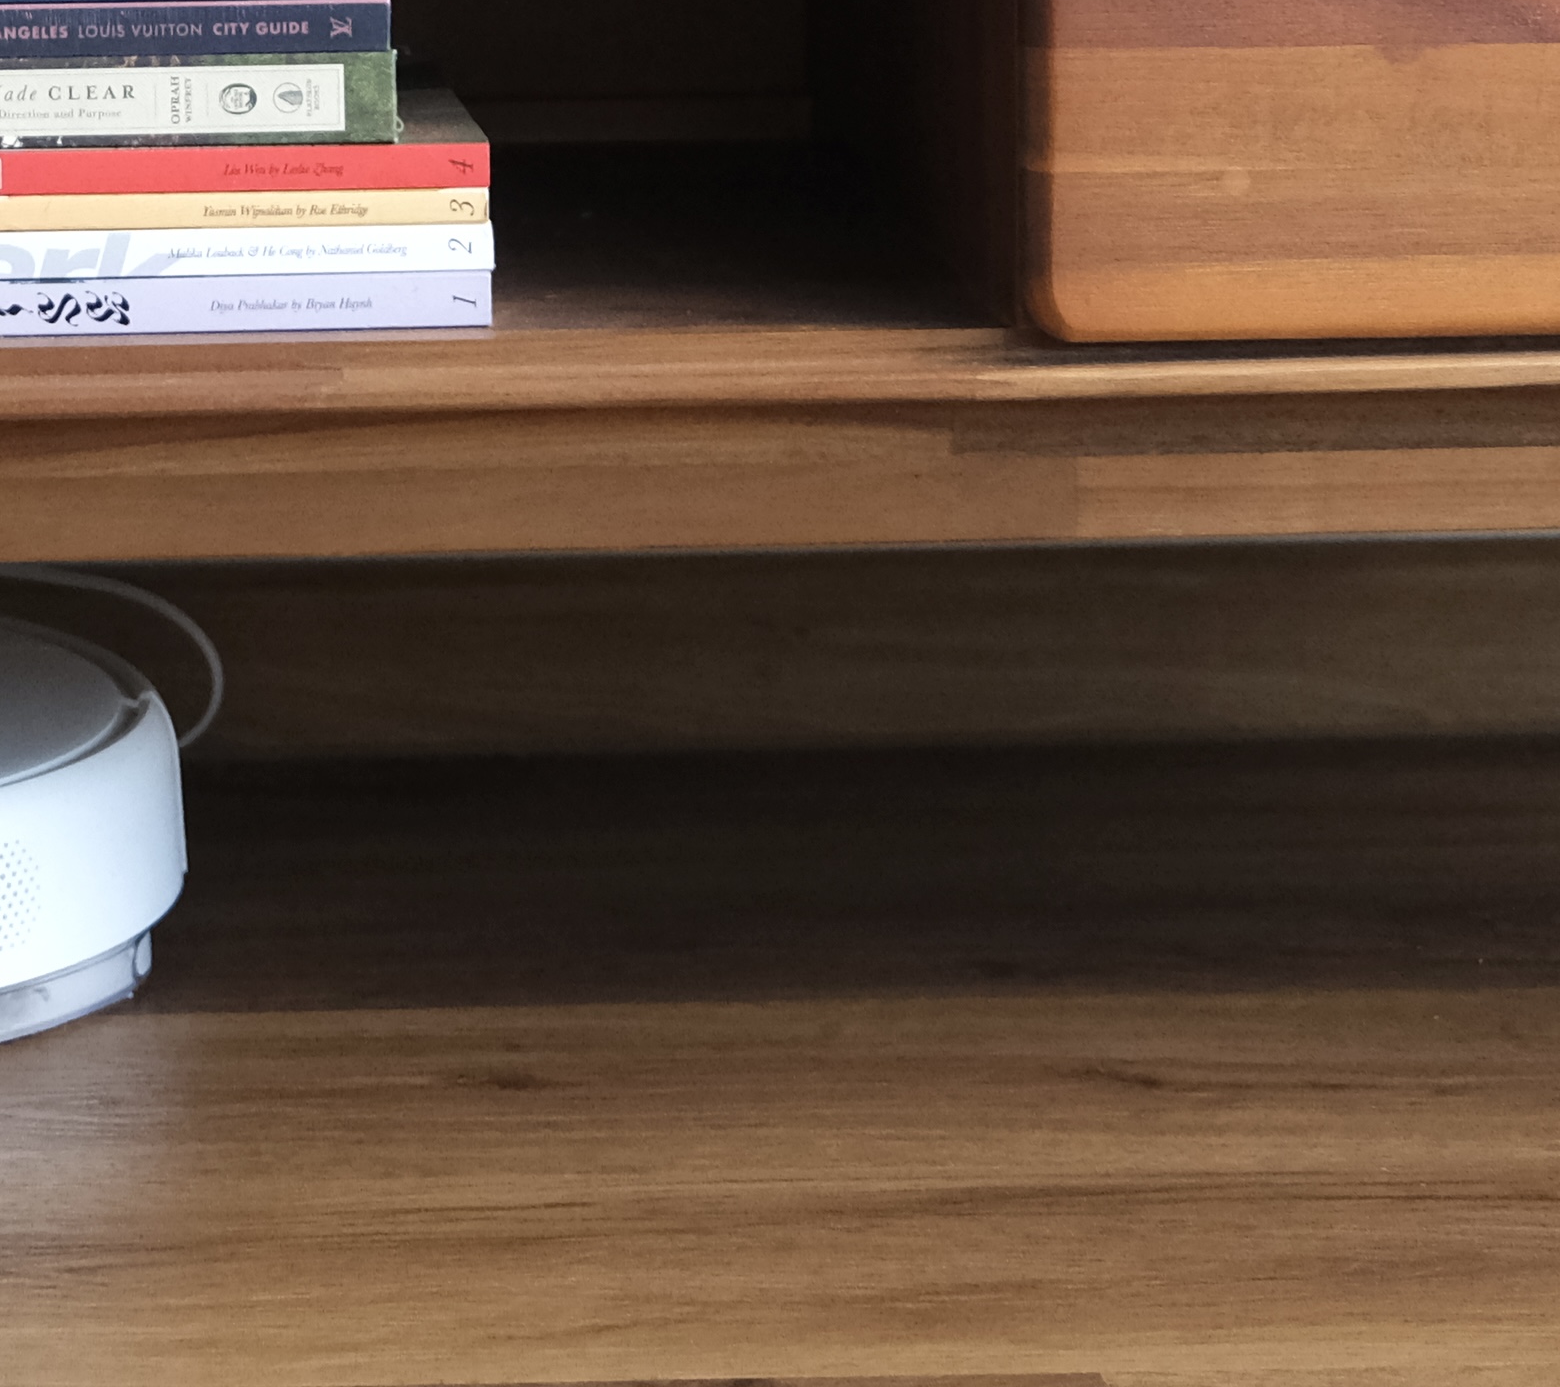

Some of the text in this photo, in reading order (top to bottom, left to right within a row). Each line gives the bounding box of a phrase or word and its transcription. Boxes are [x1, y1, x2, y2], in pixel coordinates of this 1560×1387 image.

[78, 24, 125, 39] LOUIS
[131, 23, 202, 38] VUITTON
[212, 22, 250, 36] CITY
[256, 21, 309, 36] GUIDE
[48, 84, 135, 102] CLEAR
[170, 75, 181, 125] OPRAH
[184, 77, 192, 123] WINFREY
[53, 108, 74, 119] and
[78, 108, 122, 121] Purpose
[449, 158, 474, 175] 4
[296, 204, 307, 219] by
[449, 199, 475, 216] 3
[448, 237, 472, 255] 2
[453, 295, 477, 309] 1
